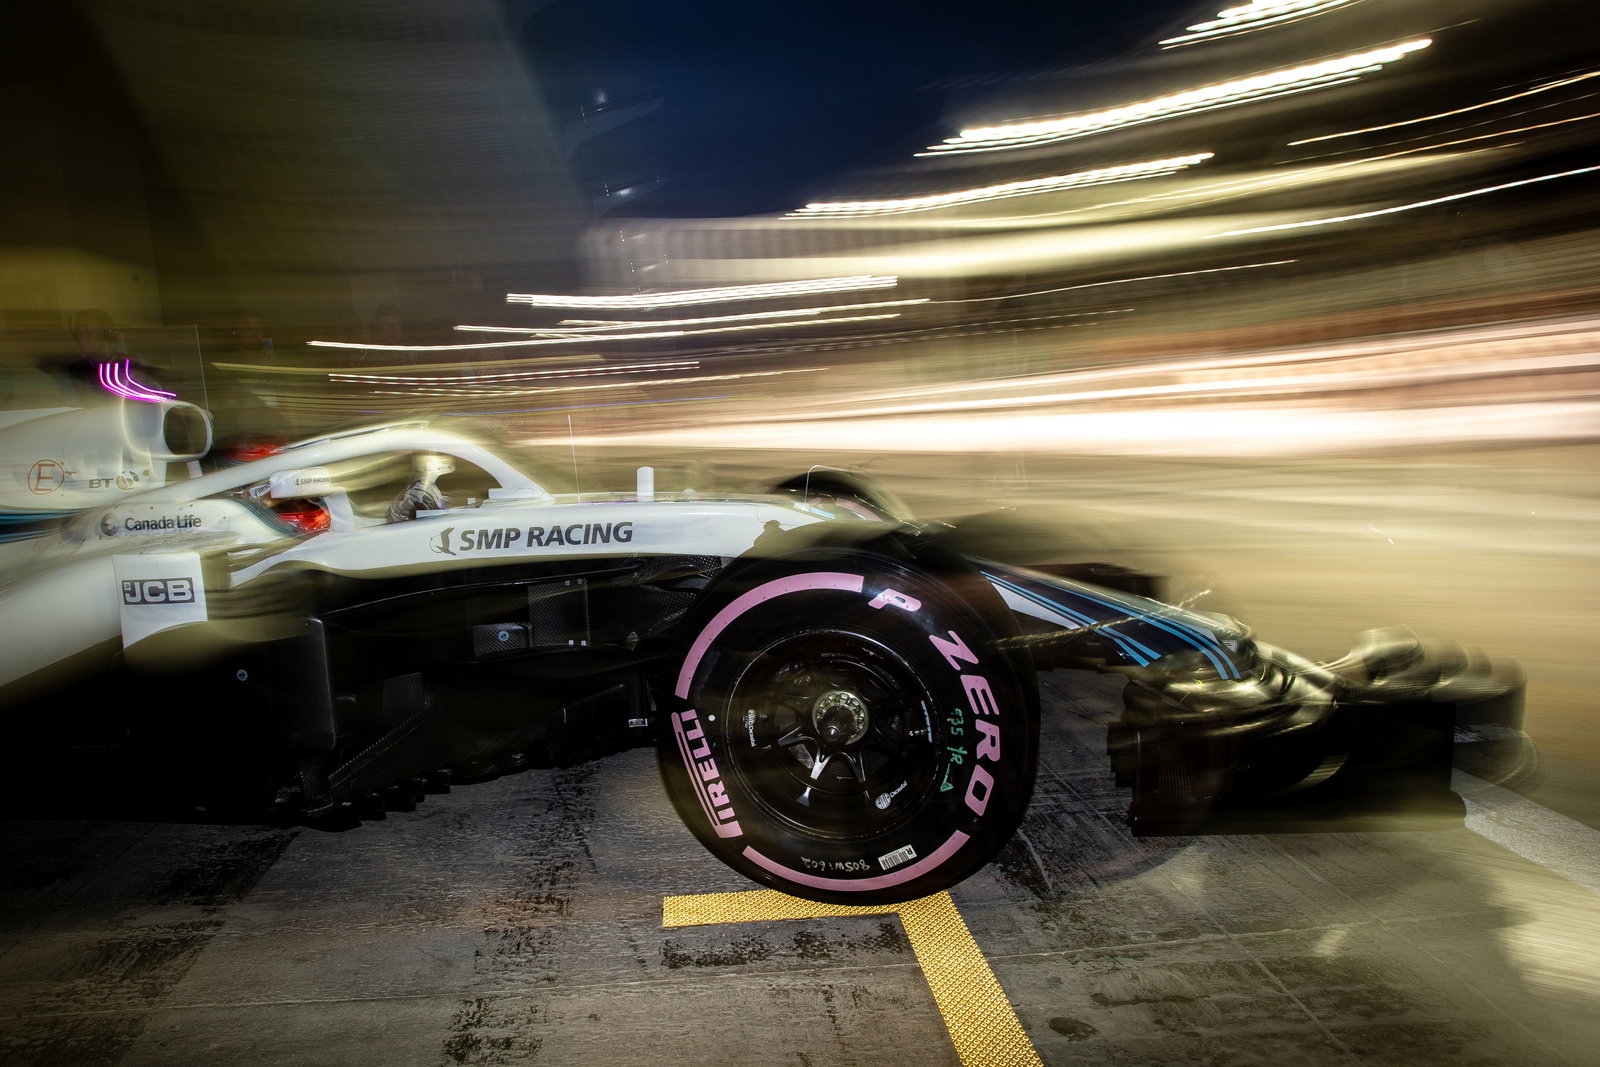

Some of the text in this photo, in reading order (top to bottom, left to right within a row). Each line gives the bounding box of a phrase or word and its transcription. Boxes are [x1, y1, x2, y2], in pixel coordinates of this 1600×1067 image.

[88, 478, 114, 489] BT
[124, 514, 202, 531] Canada Life
[459, 521, 633, 551] SMP RACING
[123, 579, 193, 604] JCB
[868, 588, 1000, 817] P ZERO
[671, 709, 744, 839] PIRELLI
[904, 847, 914, 856] R
